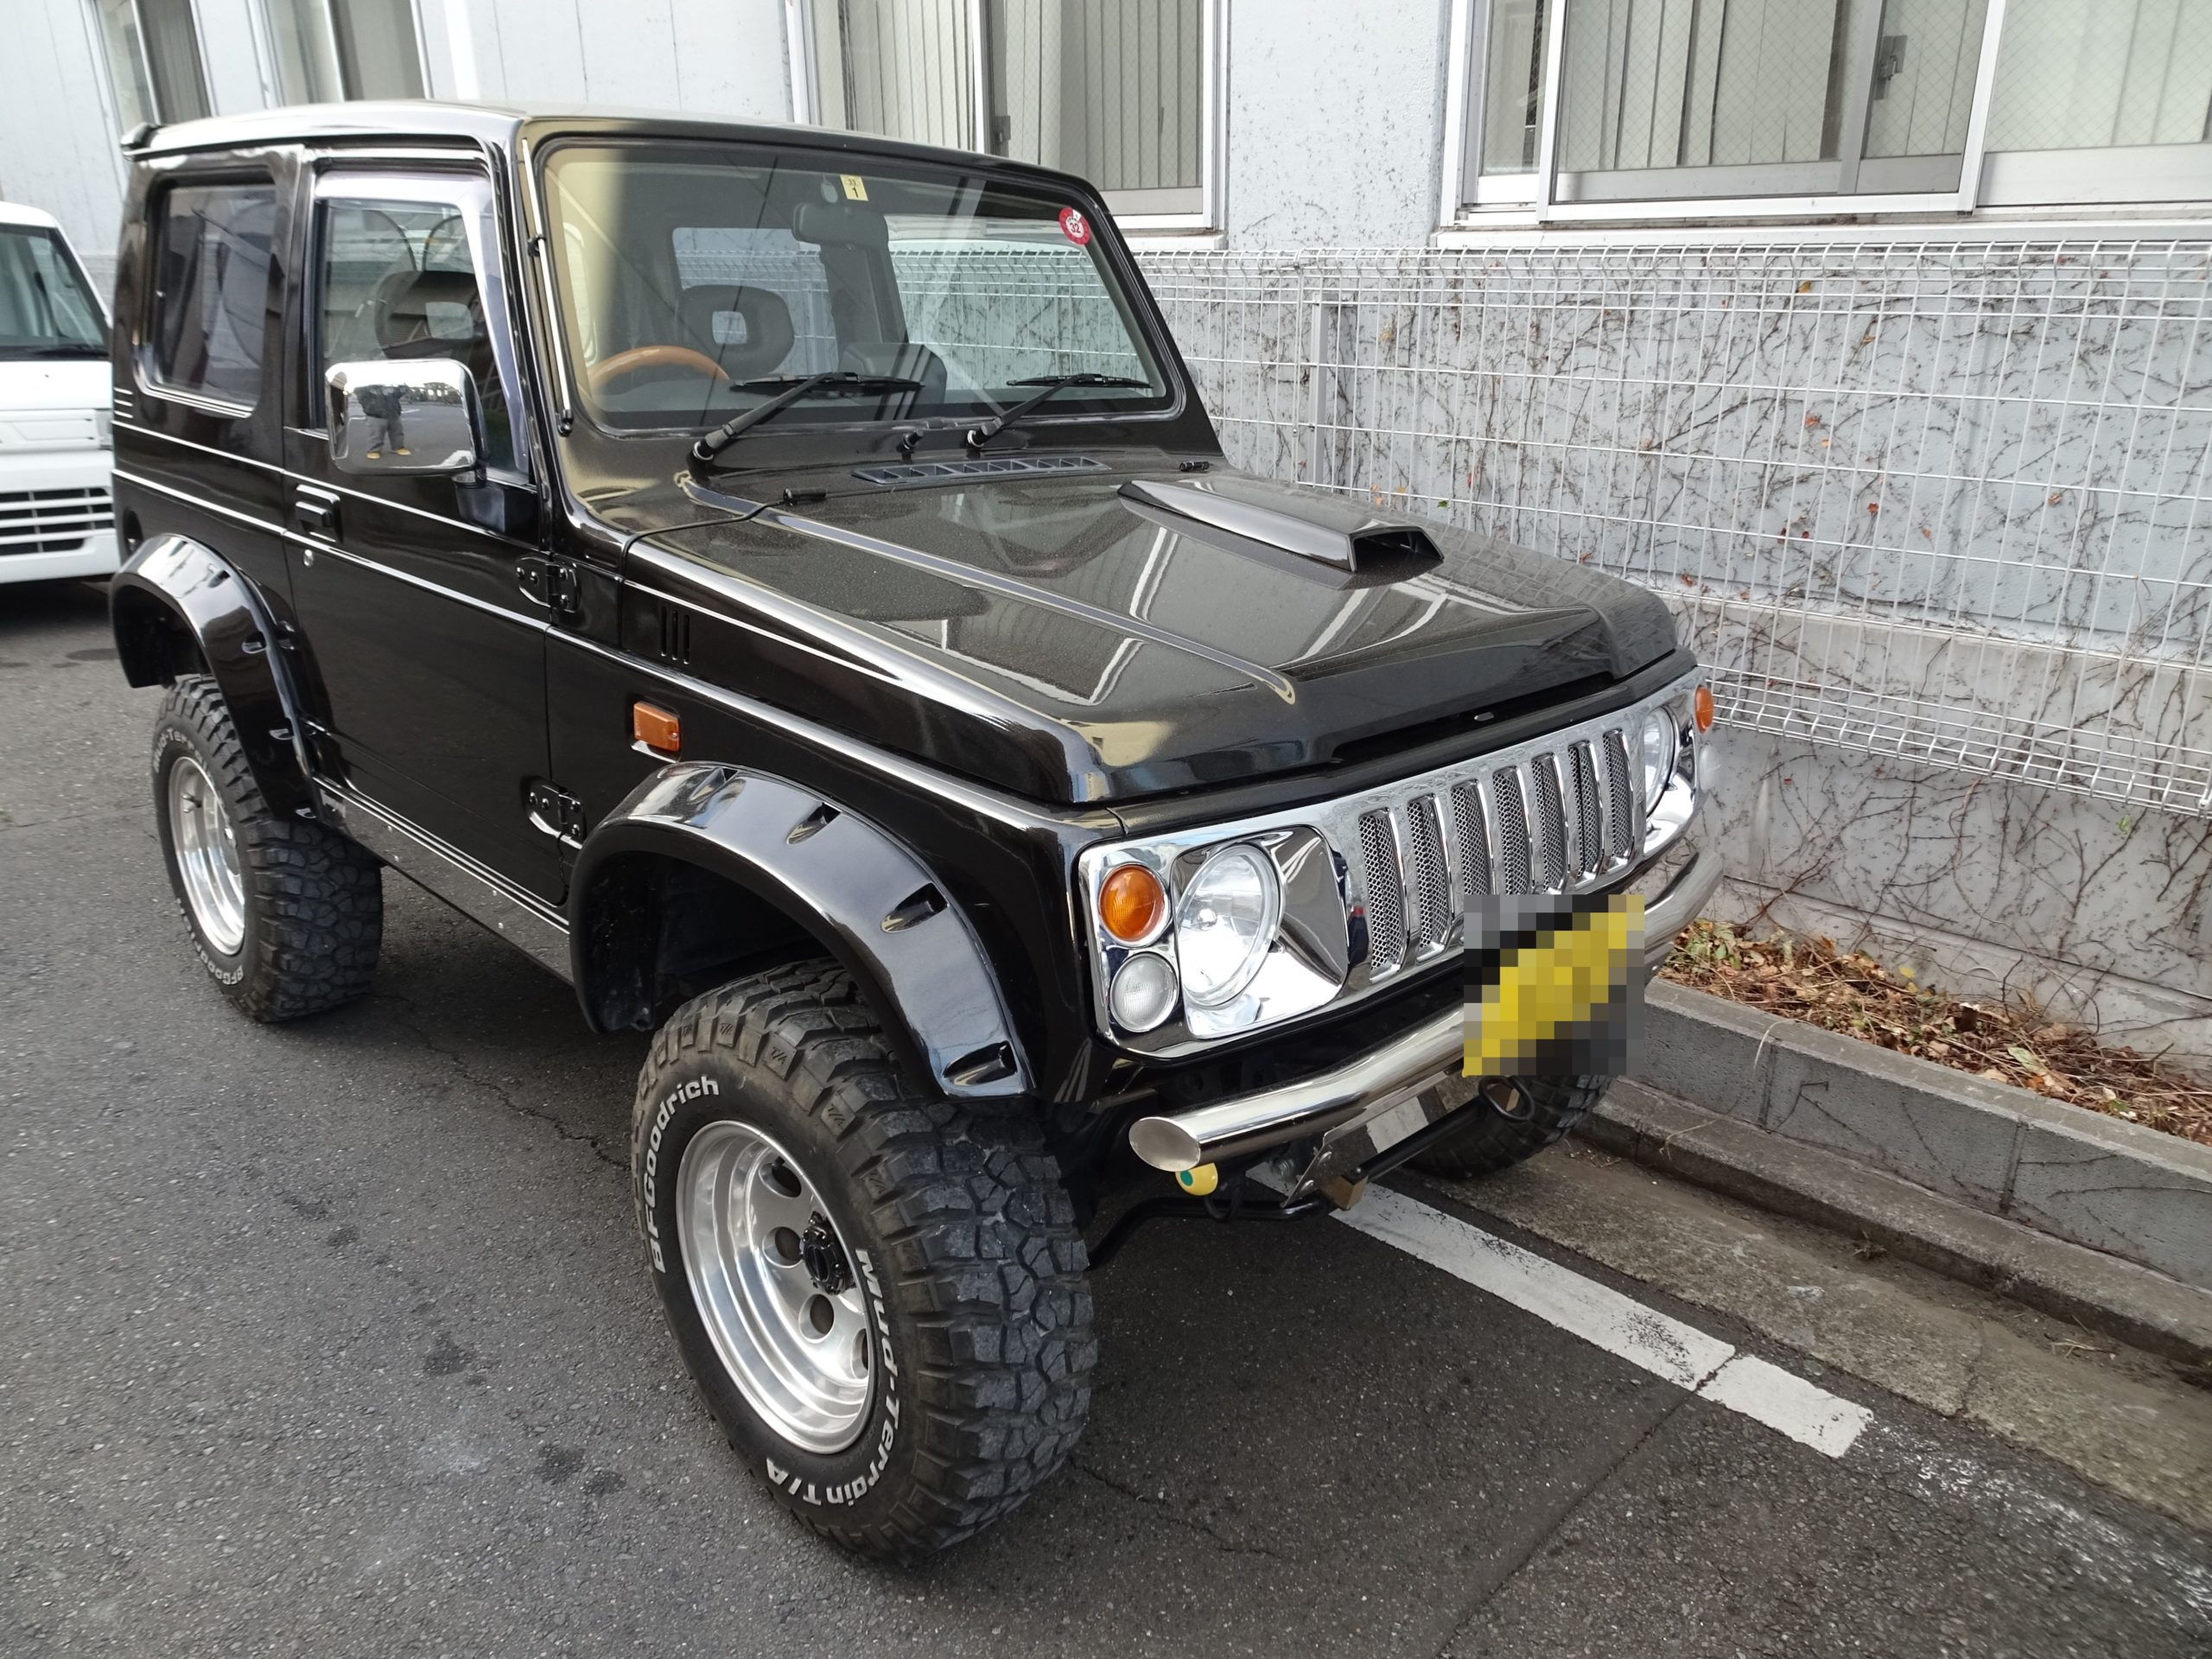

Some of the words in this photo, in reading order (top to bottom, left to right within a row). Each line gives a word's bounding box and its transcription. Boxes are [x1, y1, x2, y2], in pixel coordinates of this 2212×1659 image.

[1069, 222, 1081, 233] 32
[644, 1074, 720, 1274] BFGoodrich
[826, 1249, 900, 1507] Mud-Terrain
